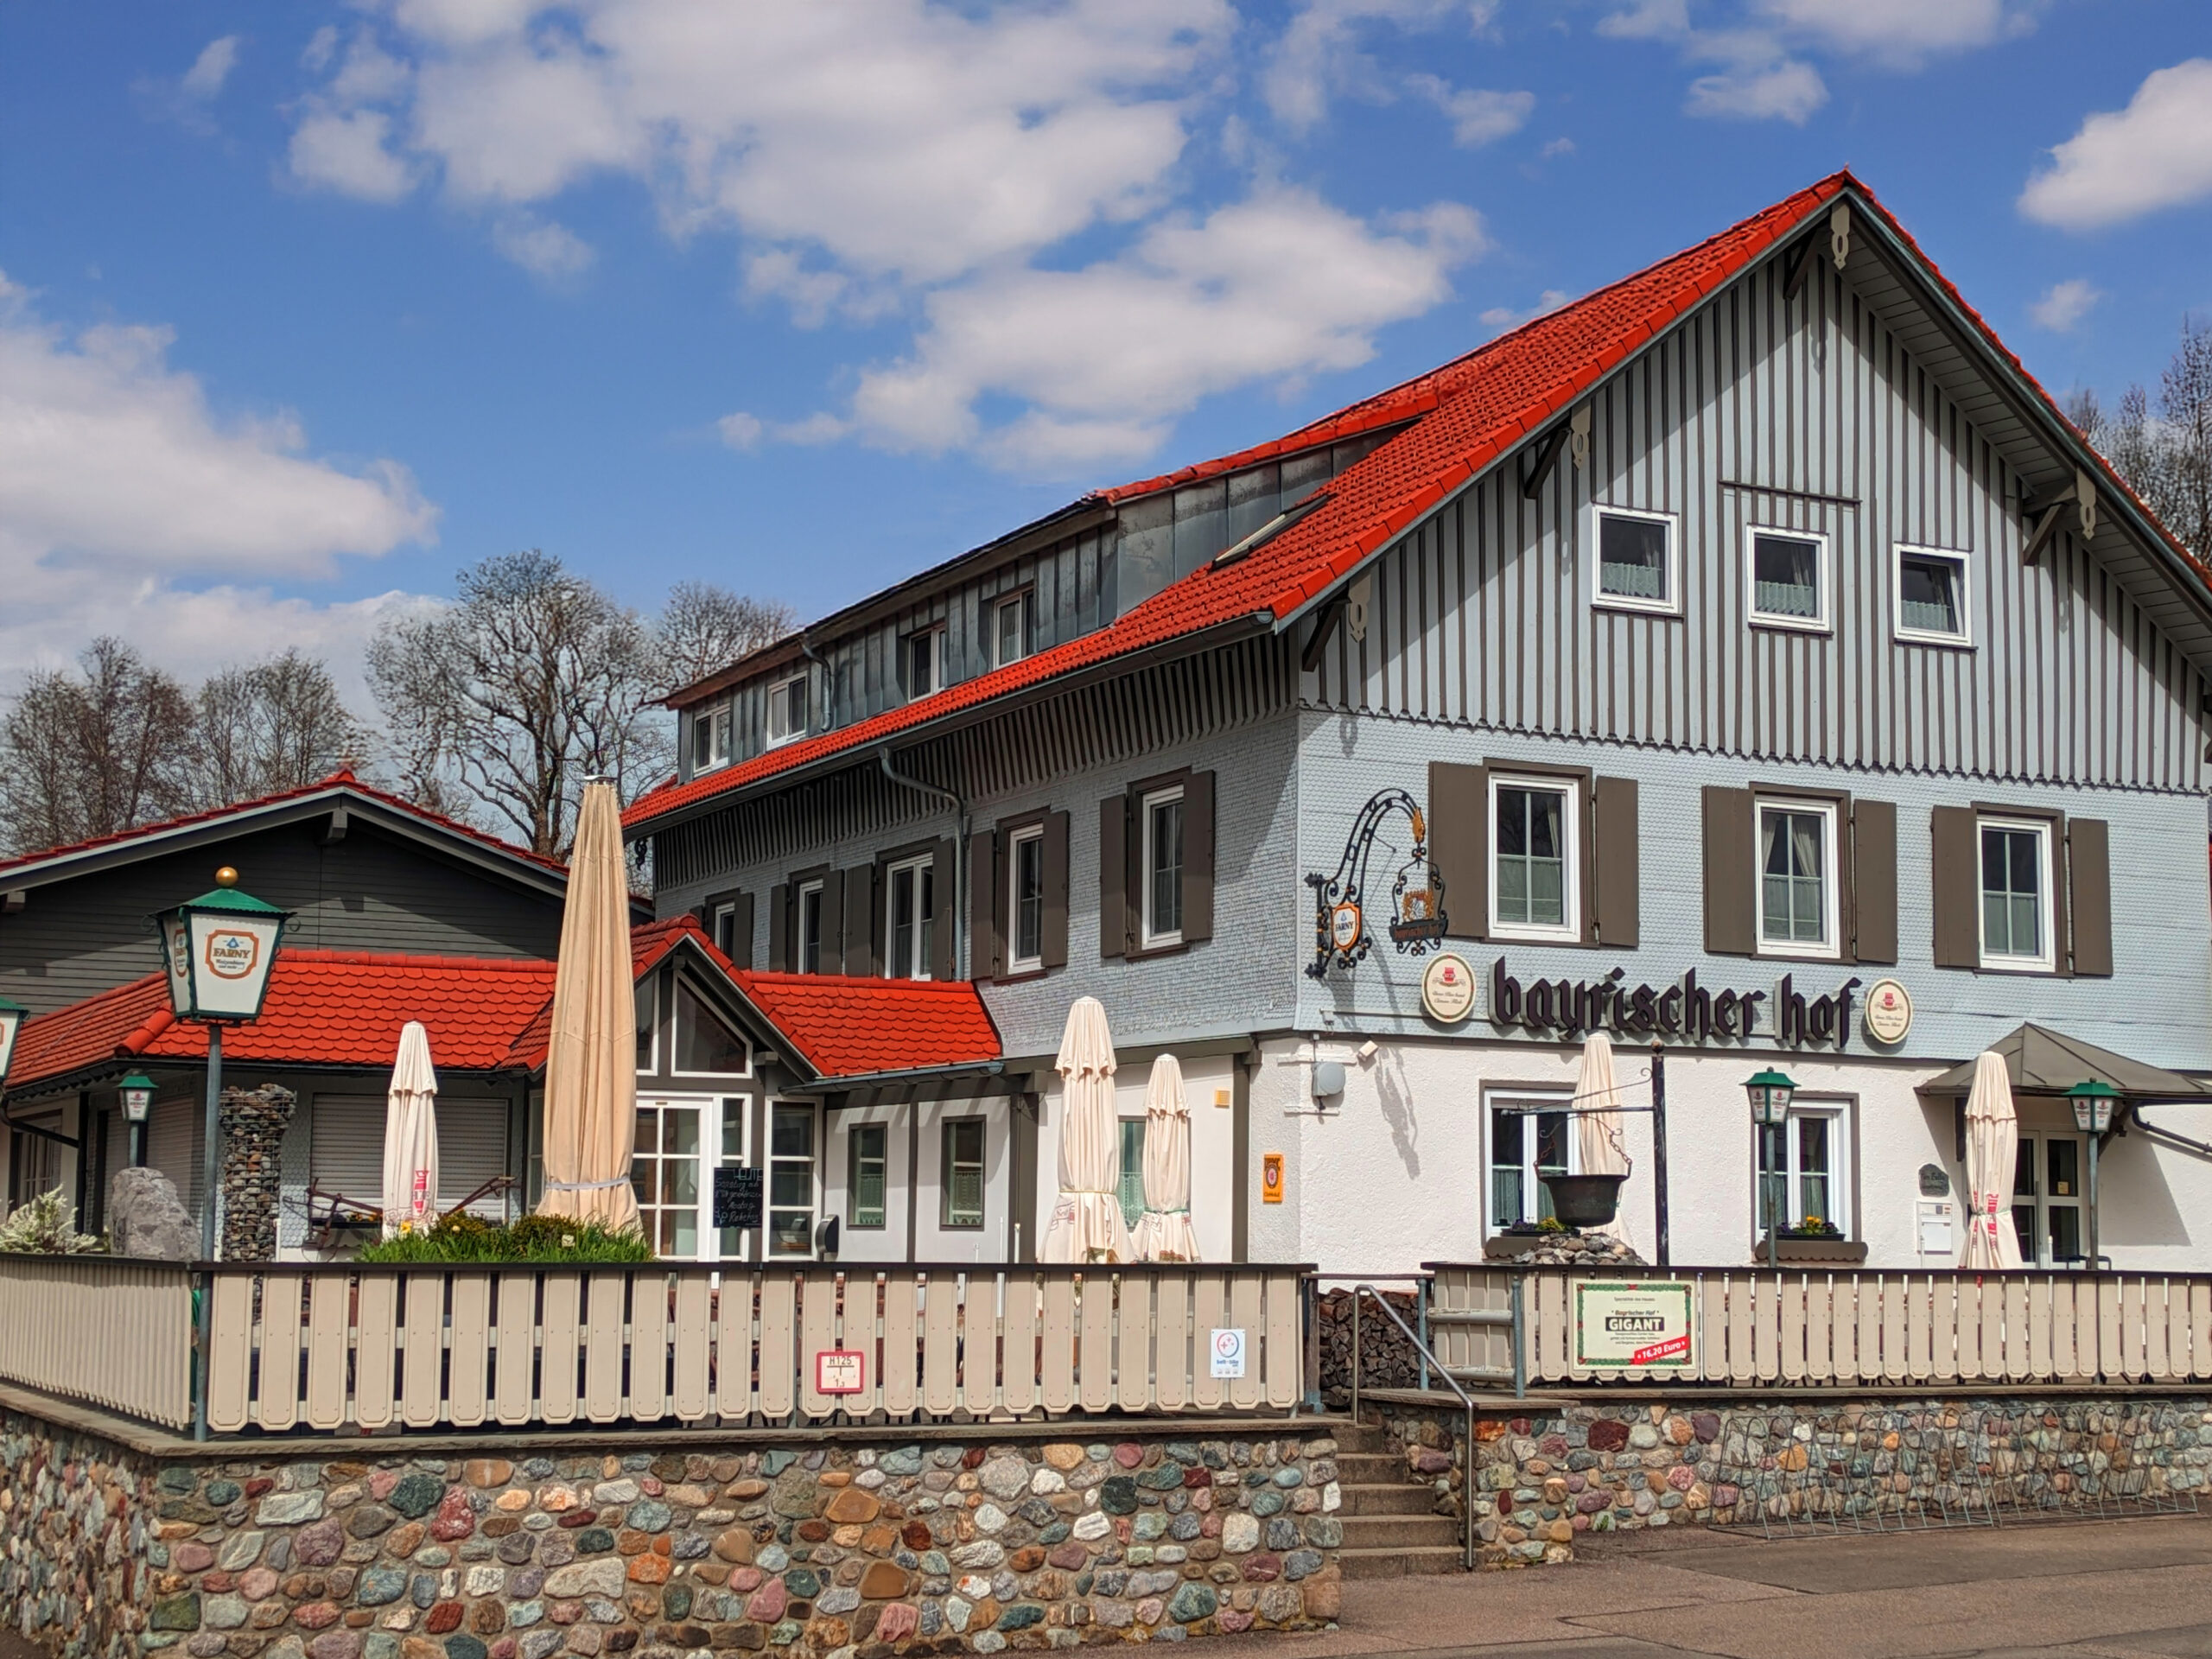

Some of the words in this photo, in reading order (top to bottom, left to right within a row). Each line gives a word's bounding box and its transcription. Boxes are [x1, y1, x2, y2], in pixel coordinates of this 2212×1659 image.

[1335, 921, 1355, 932] FARNY
[213, 947, 251, 959] FARNY
[1489, 955, 1767, 1042] bayrischer
[1775, 972, 1863, 1050] hof
[1608, 1318, 1662, 1332] GIGANT
[1642, 1346, 1662, 1359] 16,20
[1663, 1342, 1681, 1353] Euro
[830, 1356, 852, 1365] H125
